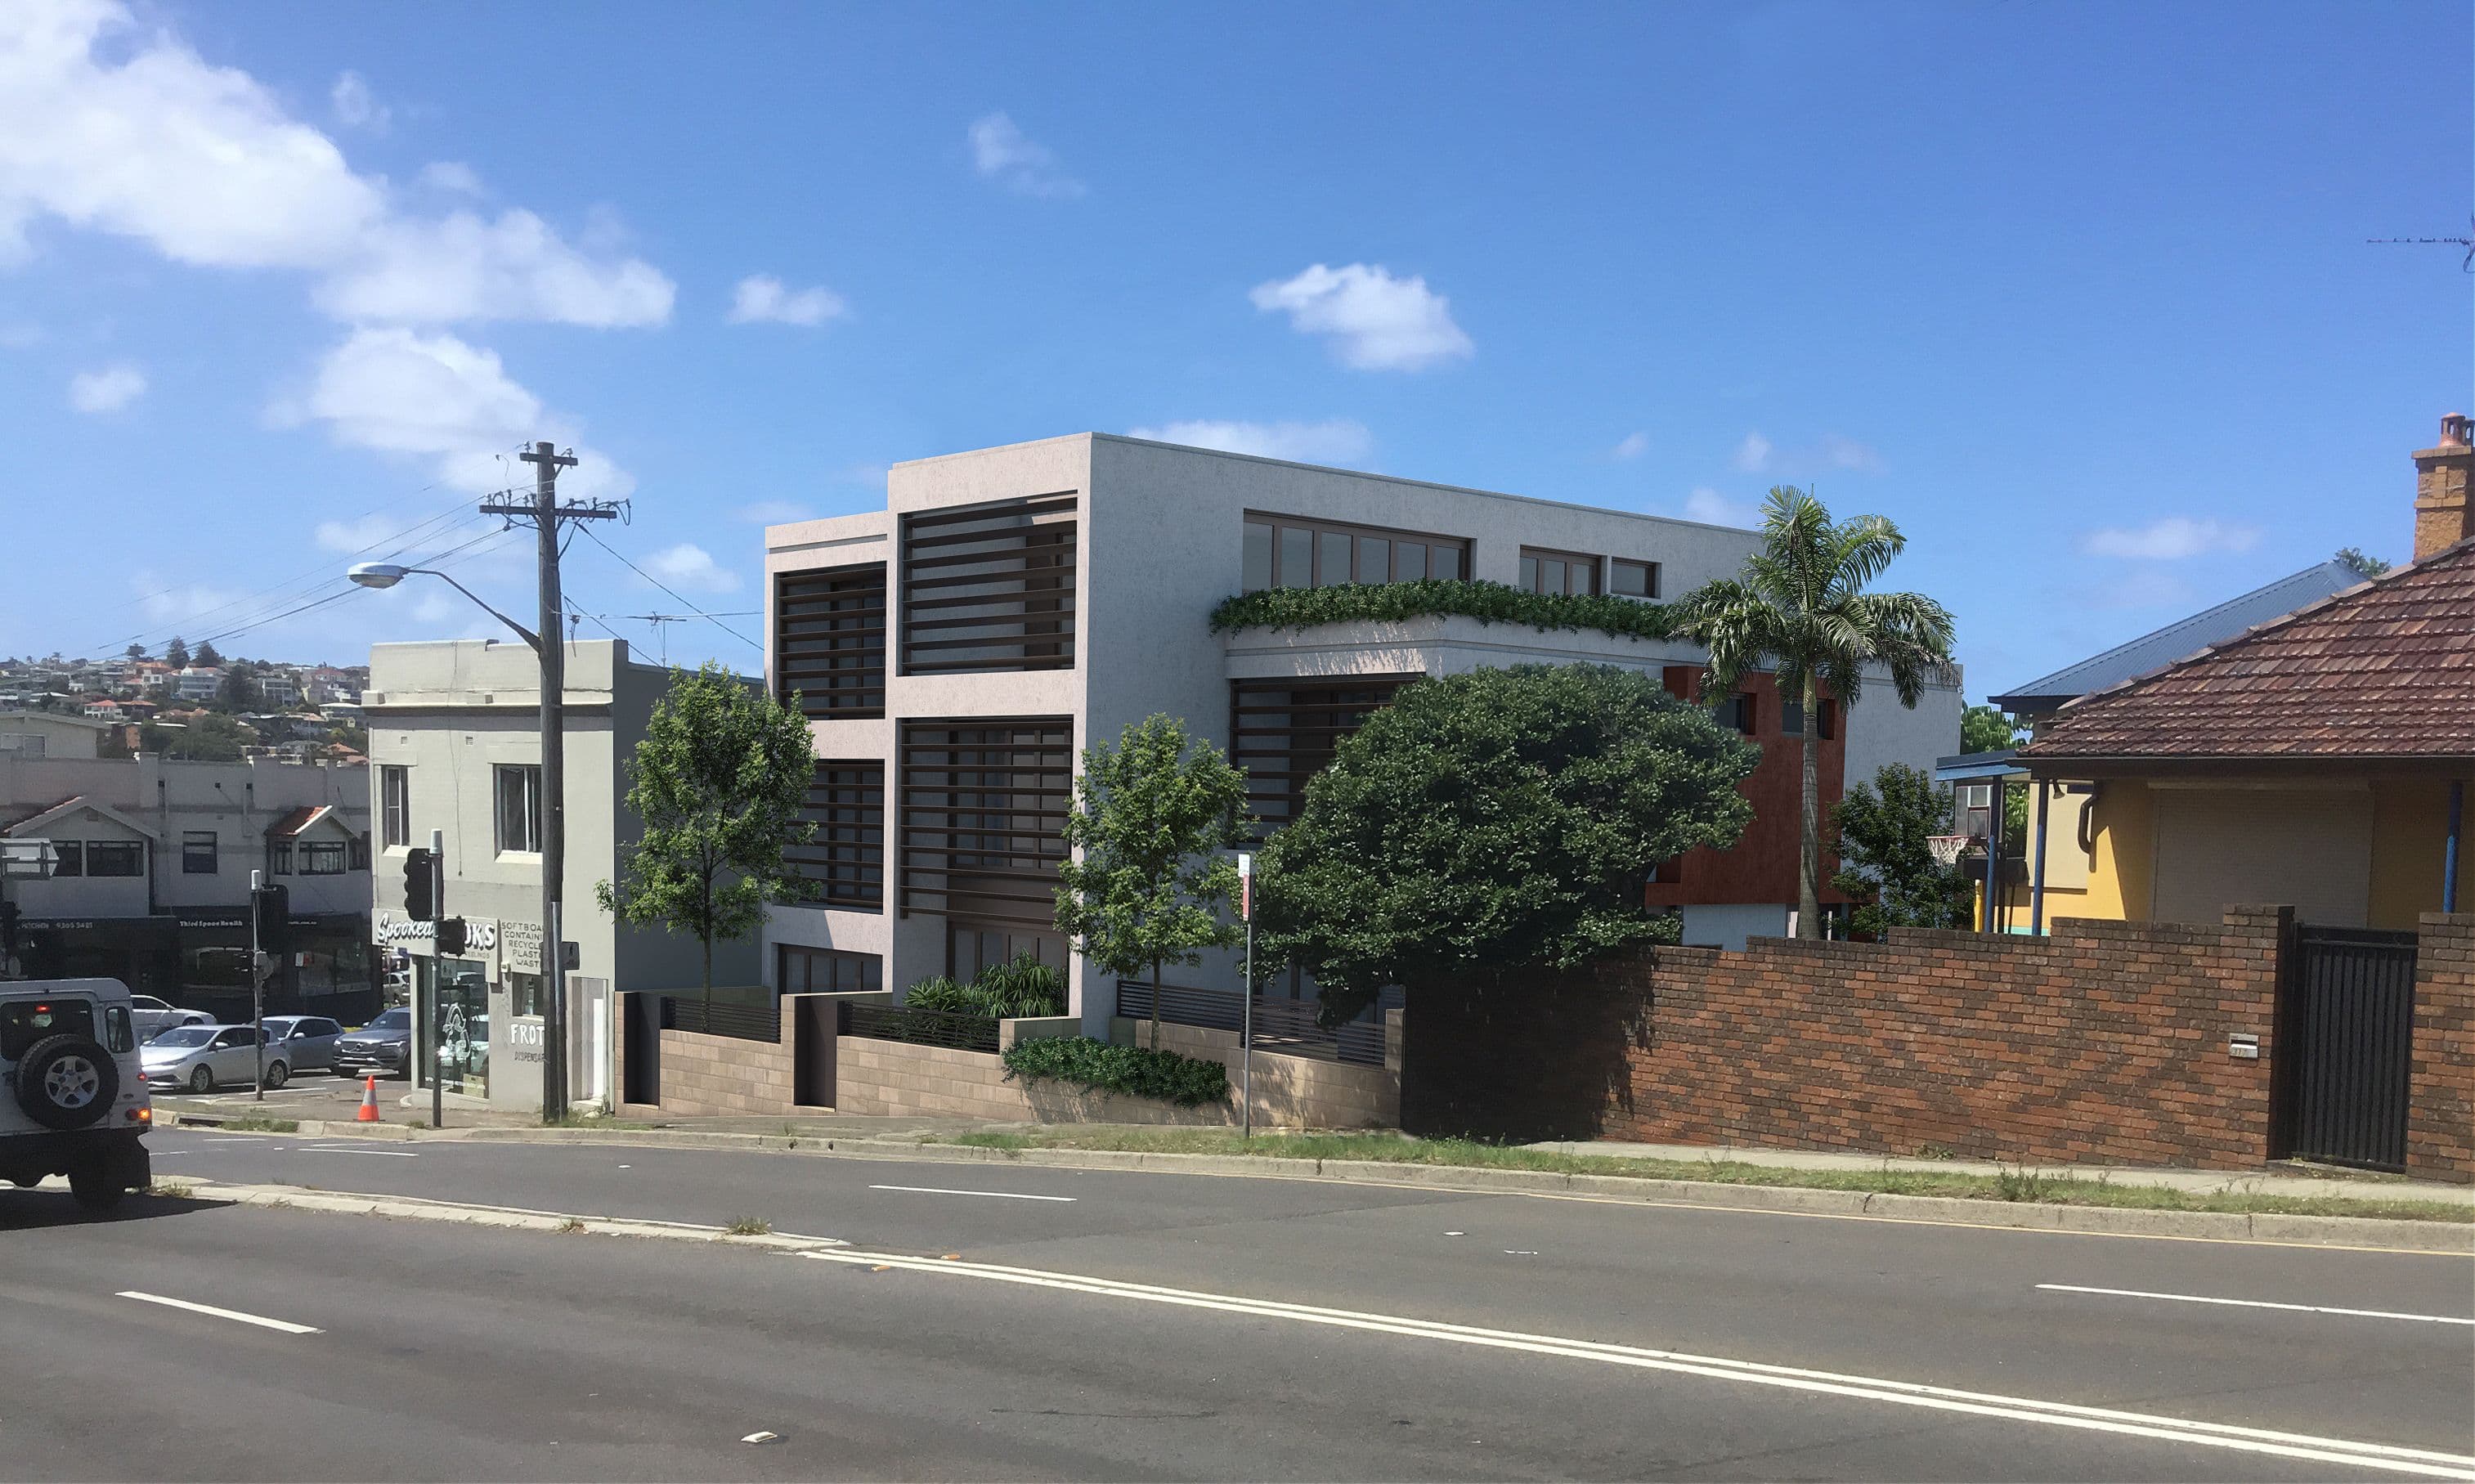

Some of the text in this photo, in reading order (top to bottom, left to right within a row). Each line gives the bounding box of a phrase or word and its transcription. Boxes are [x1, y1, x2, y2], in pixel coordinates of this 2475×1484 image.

[501, 921, 543, 932] SOFTBOA
[464, 921, 495, 951] OKS
[509, 939, 543, 950] RECYCLE
[515, 958, 540, 968] WAST
[510, 1023, 545, 1047] FROT
